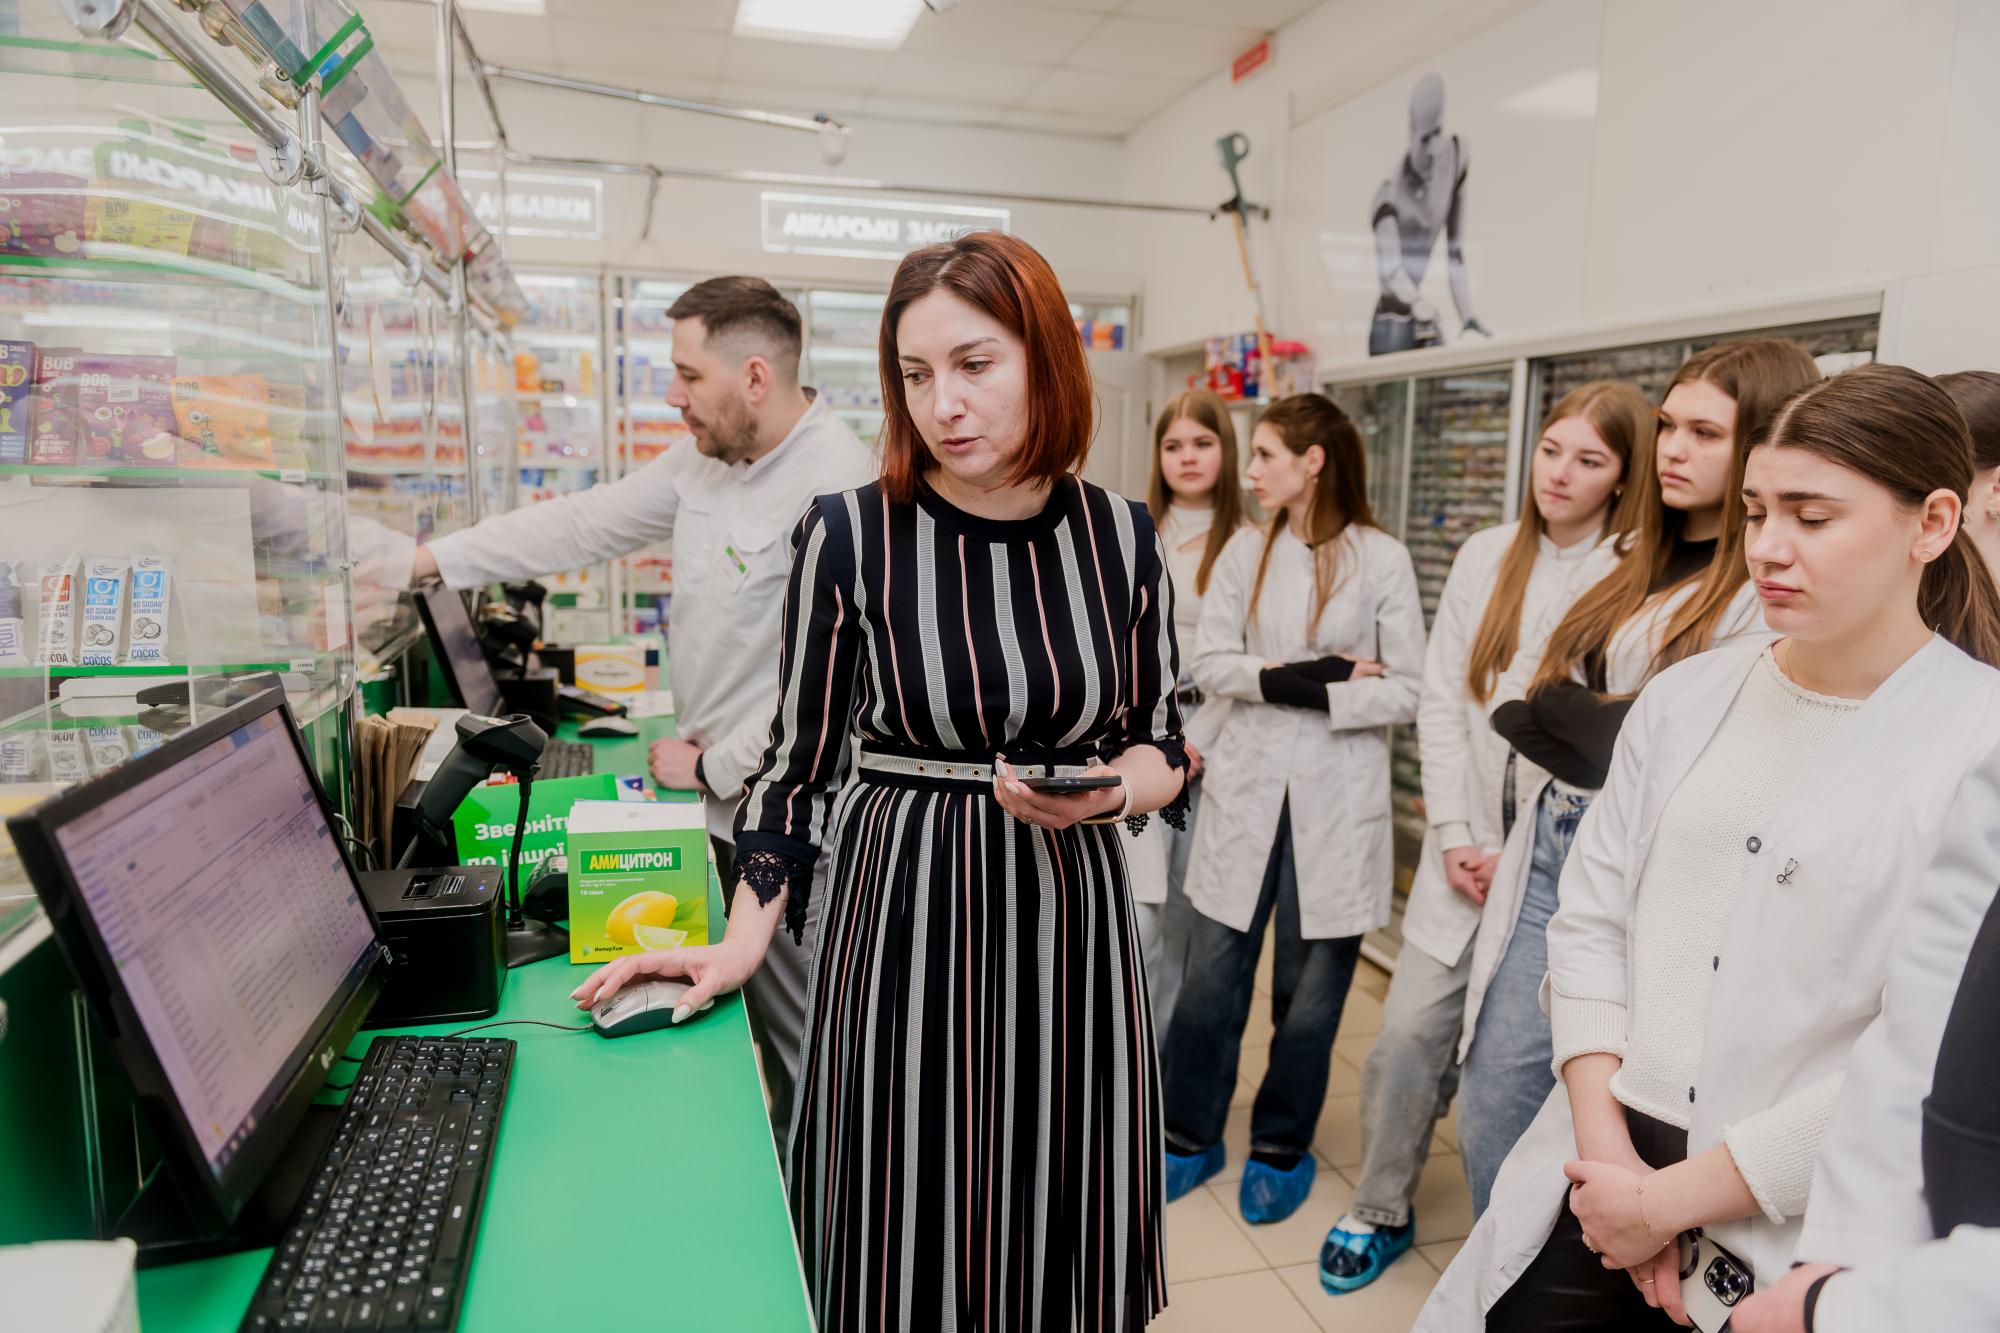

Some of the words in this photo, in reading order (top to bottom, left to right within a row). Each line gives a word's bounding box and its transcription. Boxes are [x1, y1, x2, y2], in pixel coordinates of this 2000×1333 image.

[43, 356, 75, 371] BOB
[80, 373, 110, 387] BOB
[82, 655, 112, 666] COCOS
[131, 648, 160, 659] COCOS
[589, 852, 673, 871] АМИЦИТРОН
